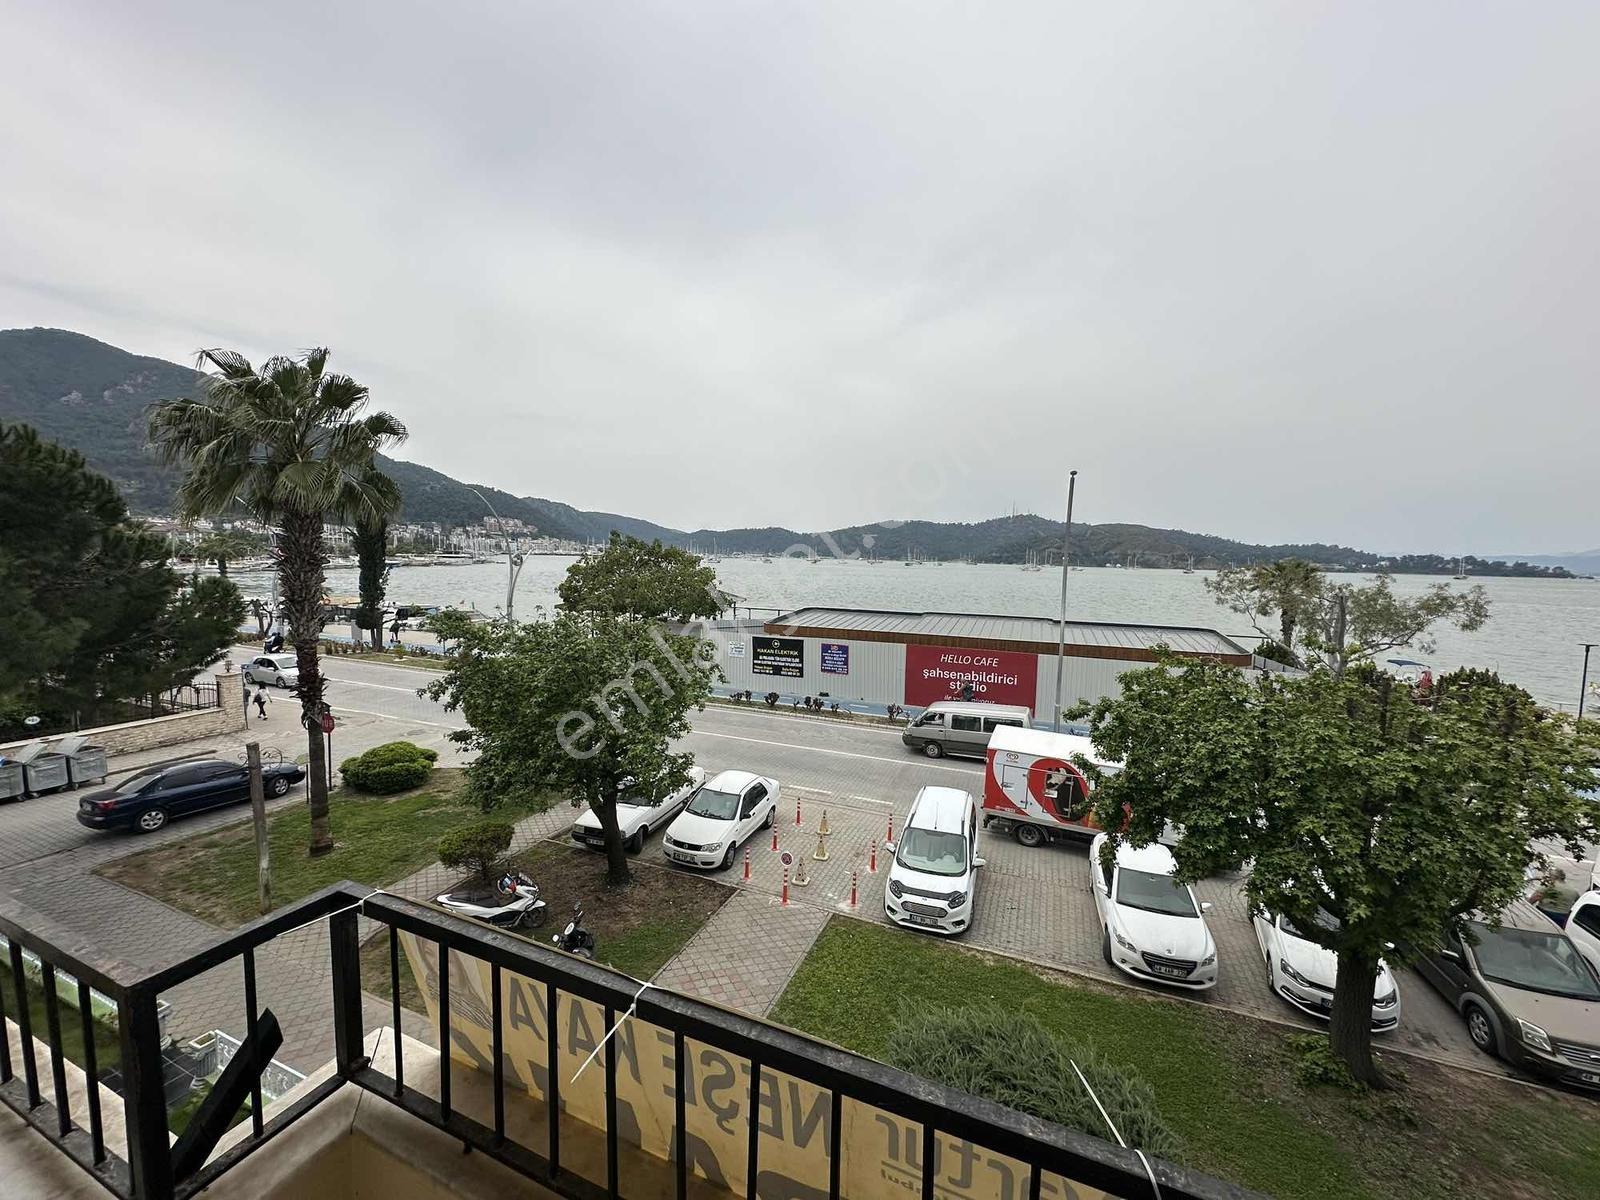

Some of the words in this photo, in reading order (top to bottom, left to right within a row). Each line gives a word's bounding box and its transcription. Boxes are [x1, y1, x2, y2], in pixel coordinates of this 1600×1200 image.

[940, 654, 972, 665] HELLO
[973, 656, 1000, 667] CAFE
[922, 667, 1018, 686] şahsenabildirici
[949, 680, 987, 692] stdio
